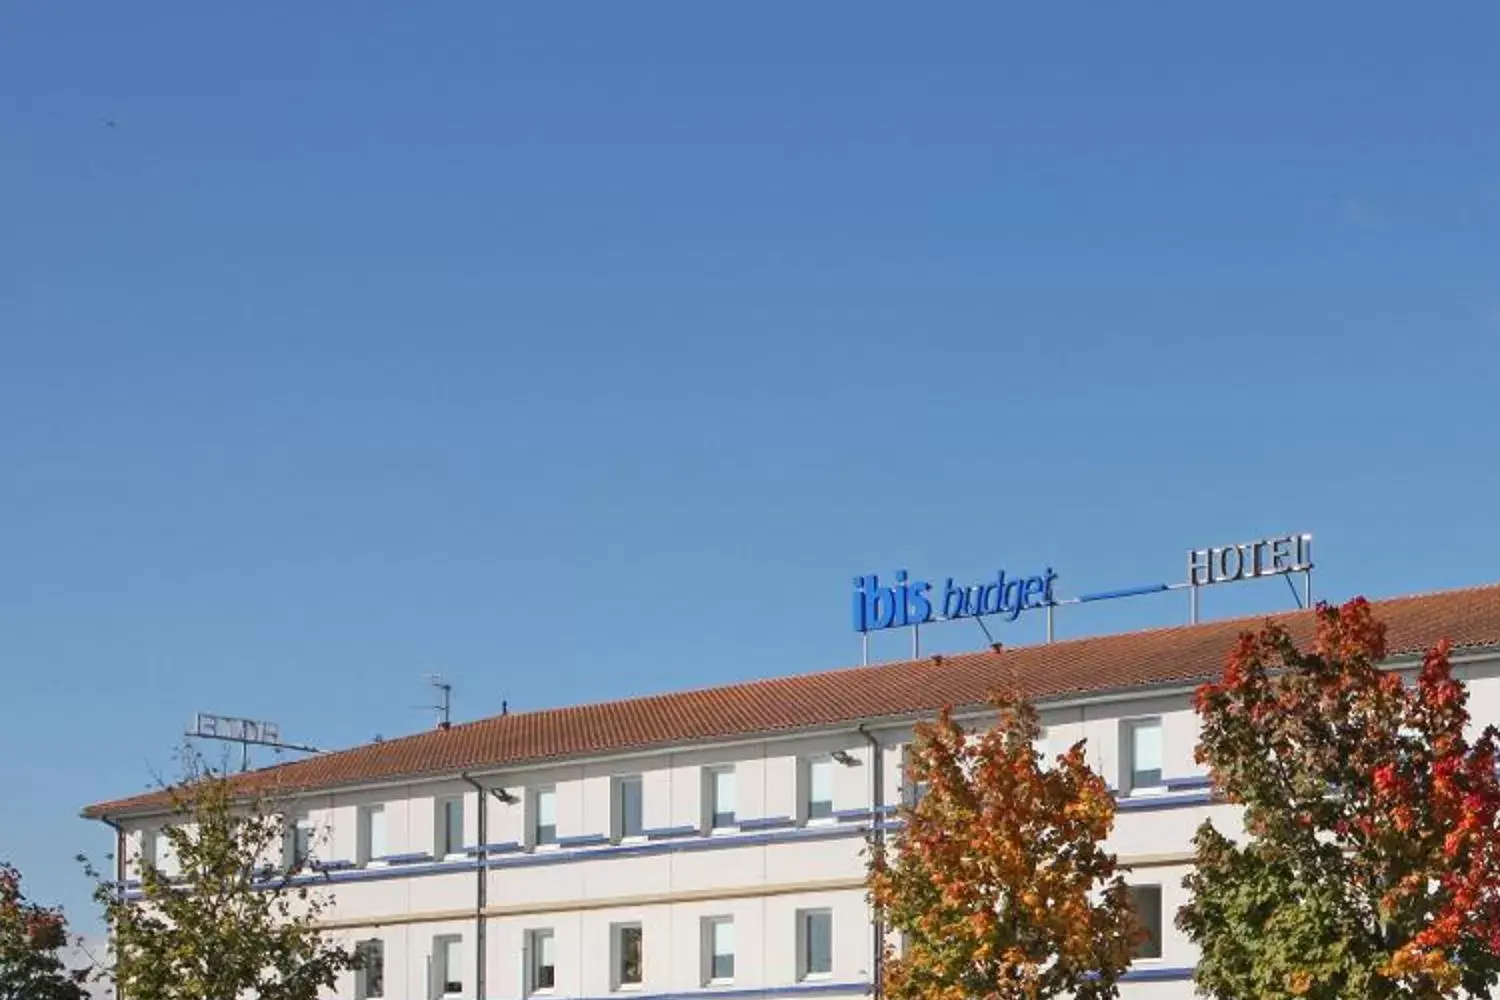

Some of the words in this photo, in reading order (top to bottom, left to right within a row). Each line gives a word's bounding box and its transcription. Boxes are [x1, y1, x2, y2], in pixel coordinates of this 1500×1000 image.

[1188, 534, 1313, 586] HOTEL
[852, 569, 932, 632] ibis
[943, 567, 1058, 621] budget
